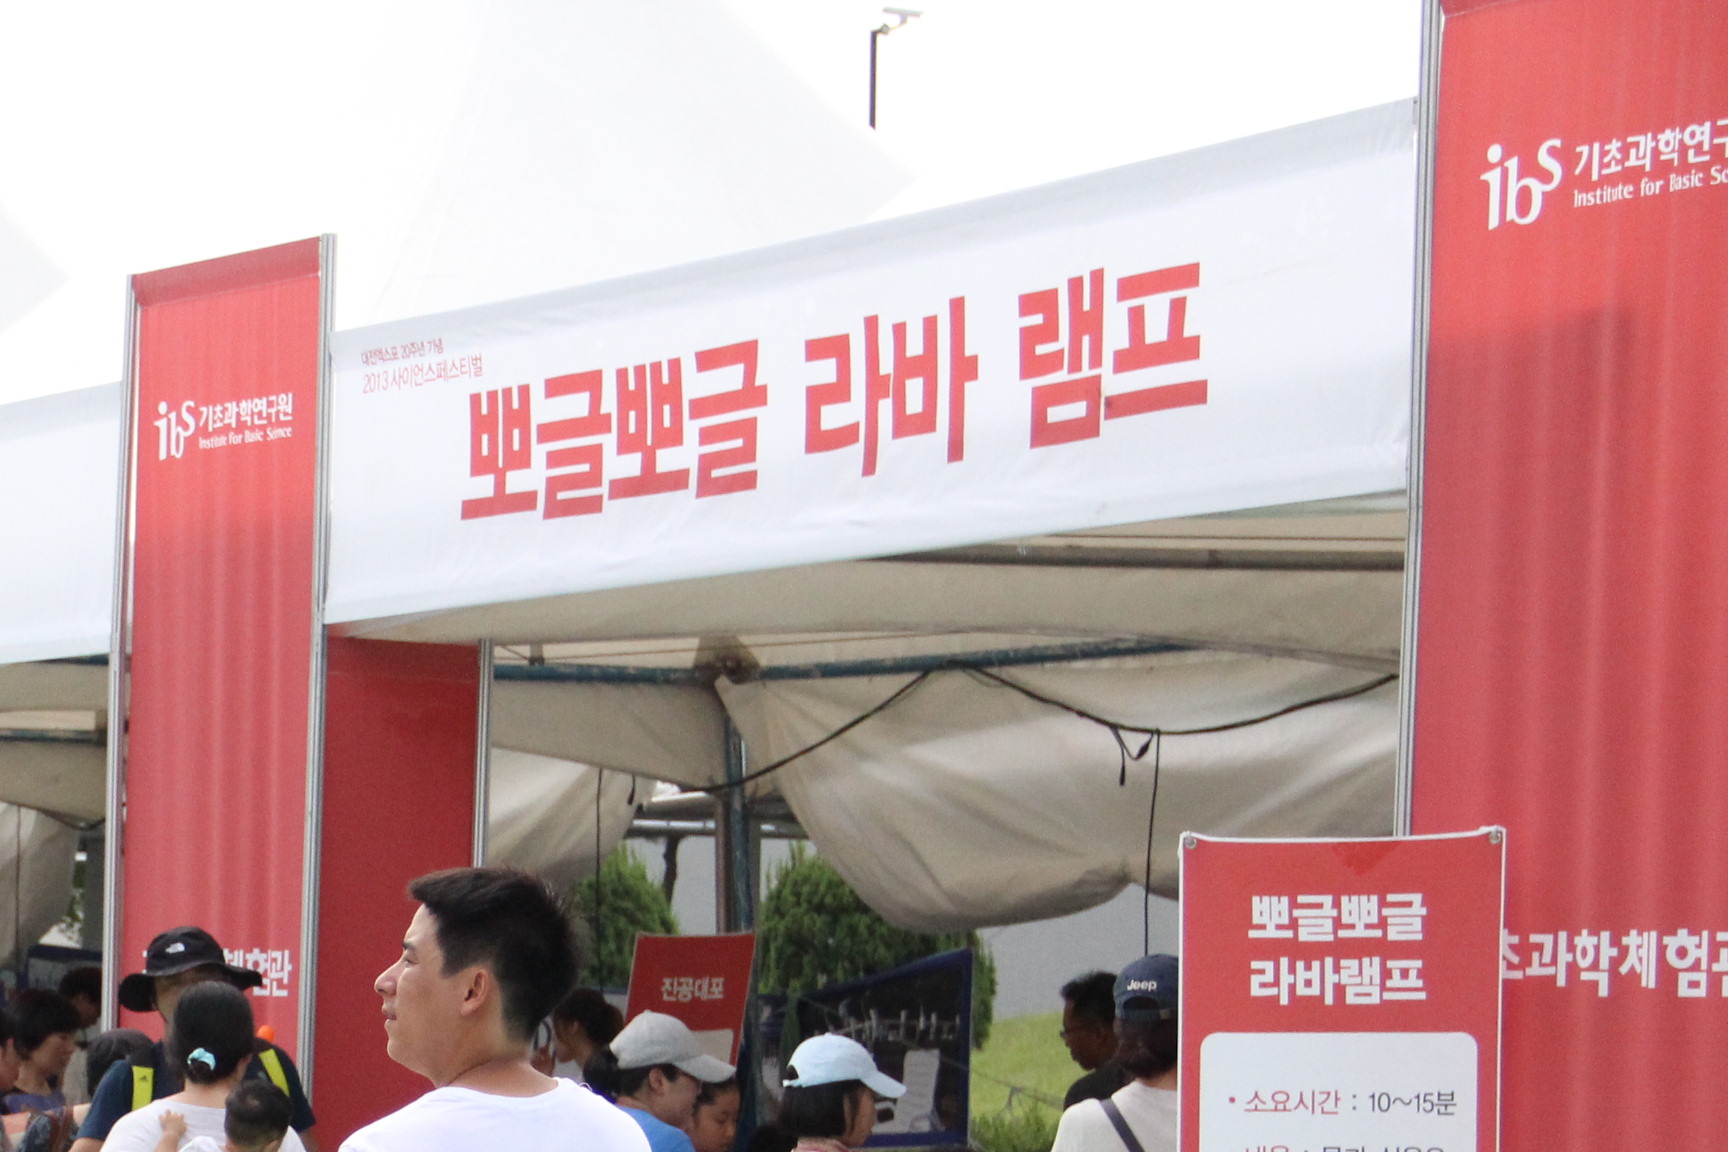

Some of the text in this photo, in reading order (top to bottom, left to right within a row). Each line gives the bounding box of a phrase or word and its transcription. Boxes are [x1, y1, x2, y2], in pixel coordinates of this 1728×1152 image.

[1574, 184, 1634, 208] Institute
[1640, 178, 1664, 197] for
[1670, 169, 1704, 192] Basic
[363, 353, 483, 394] 2013 사이언스페스티벌
[460, 261, 1208, 520] 뽀글뽀글 라바 램프
[199, 392, 293, 432] 기초과학연구원
[229, 431, 242, 445] for
[1248, 893, 1427, 942] 뽀글뽀글
[1250, 956, 1427, 1006] 라바램프
[1502, 928, 1728, 998] 초과학체험
[661, 976, 725, 1003] 진공대포
[1127, 979, 1158, 992] Jeep
[1244, 1089, 1341, 1116] 소요시간
